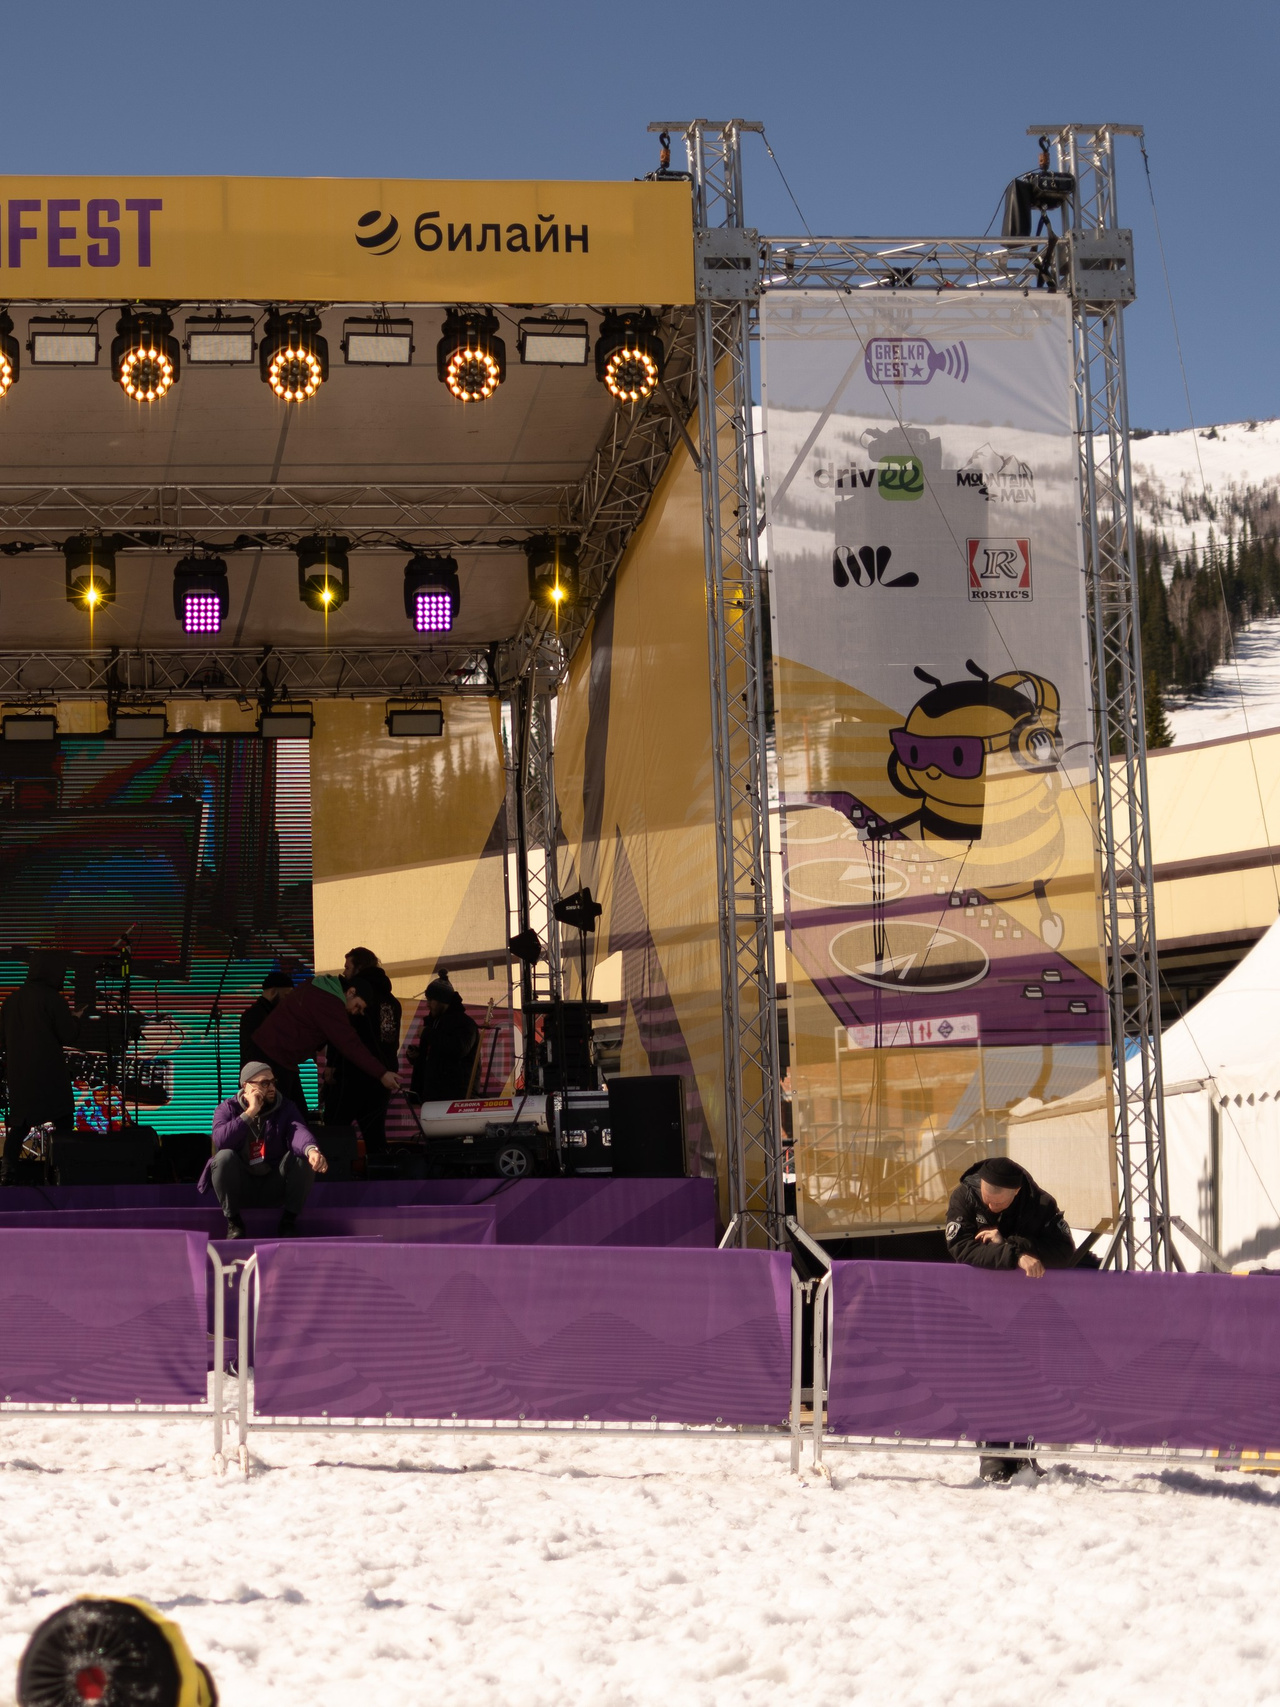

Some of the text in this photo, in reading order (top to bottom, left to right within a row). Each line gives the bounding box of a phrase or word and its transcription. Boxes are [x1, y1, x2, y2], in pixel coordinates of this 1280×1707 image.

[413, 210, 590, 254] билайн
[875, 344, 925, 360] GRELKA
[876, 362, 909, 378] FEST
[813, 461, 925, 493] drivee
[957, 472, 1034, 489] MOUNTAIN
[1000, 488, 1037, 503] MAN
[971, 590, 1030, 599] ROSTIC'S
